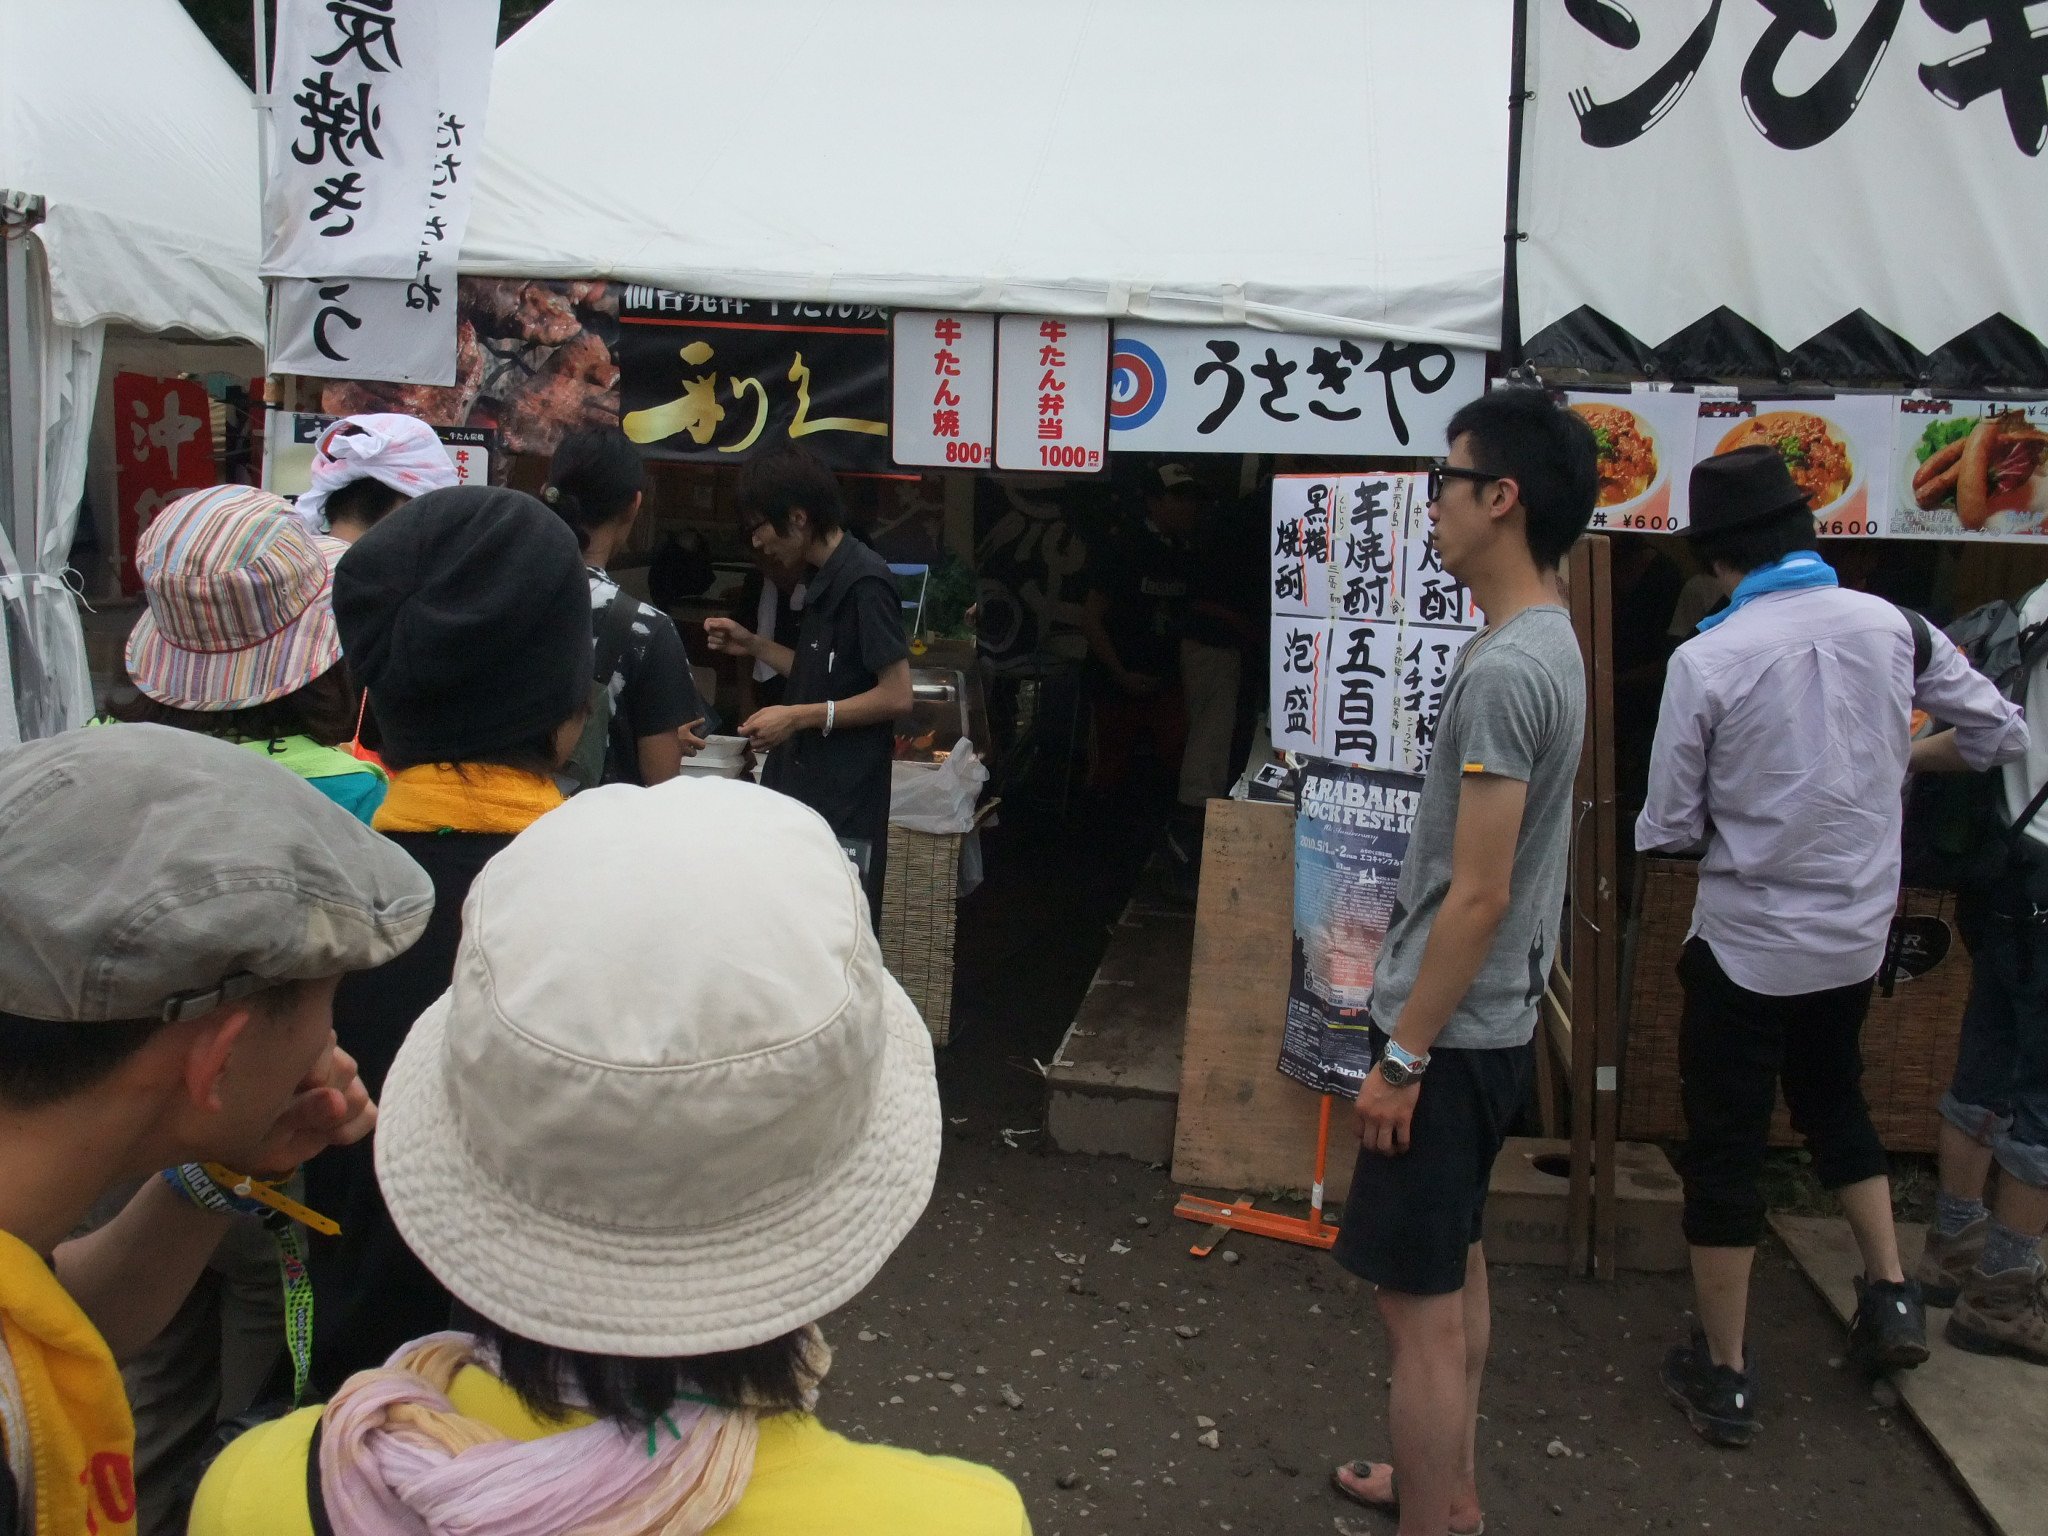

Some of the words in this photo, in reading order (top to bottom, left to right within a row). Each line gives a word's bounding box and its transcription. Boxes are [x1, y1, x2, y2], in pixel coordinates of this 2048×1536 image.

[932, 318, 962, 437] 牛たん焼
[1037, 320, 1067, 440] 牛たん弁当
[1194, 340, 1455, 446] うさぎや
[1039, 445, 1099, 467] 1000円
[1274, 518, 1305, 601] 焼酎
[1342, 480, 1393, 618] 芋焼酎
[1623, 514, 1678, 531] ¥600
[1819, 520, 1878, 535] ¥600
[1283, 628, 1314, 735] 泡盛
[1335, 628, 1386, 763] 五百円
[1404, 638, 1425, 712] イチゴ
[1301, 798, 1342, 823] ROCK
